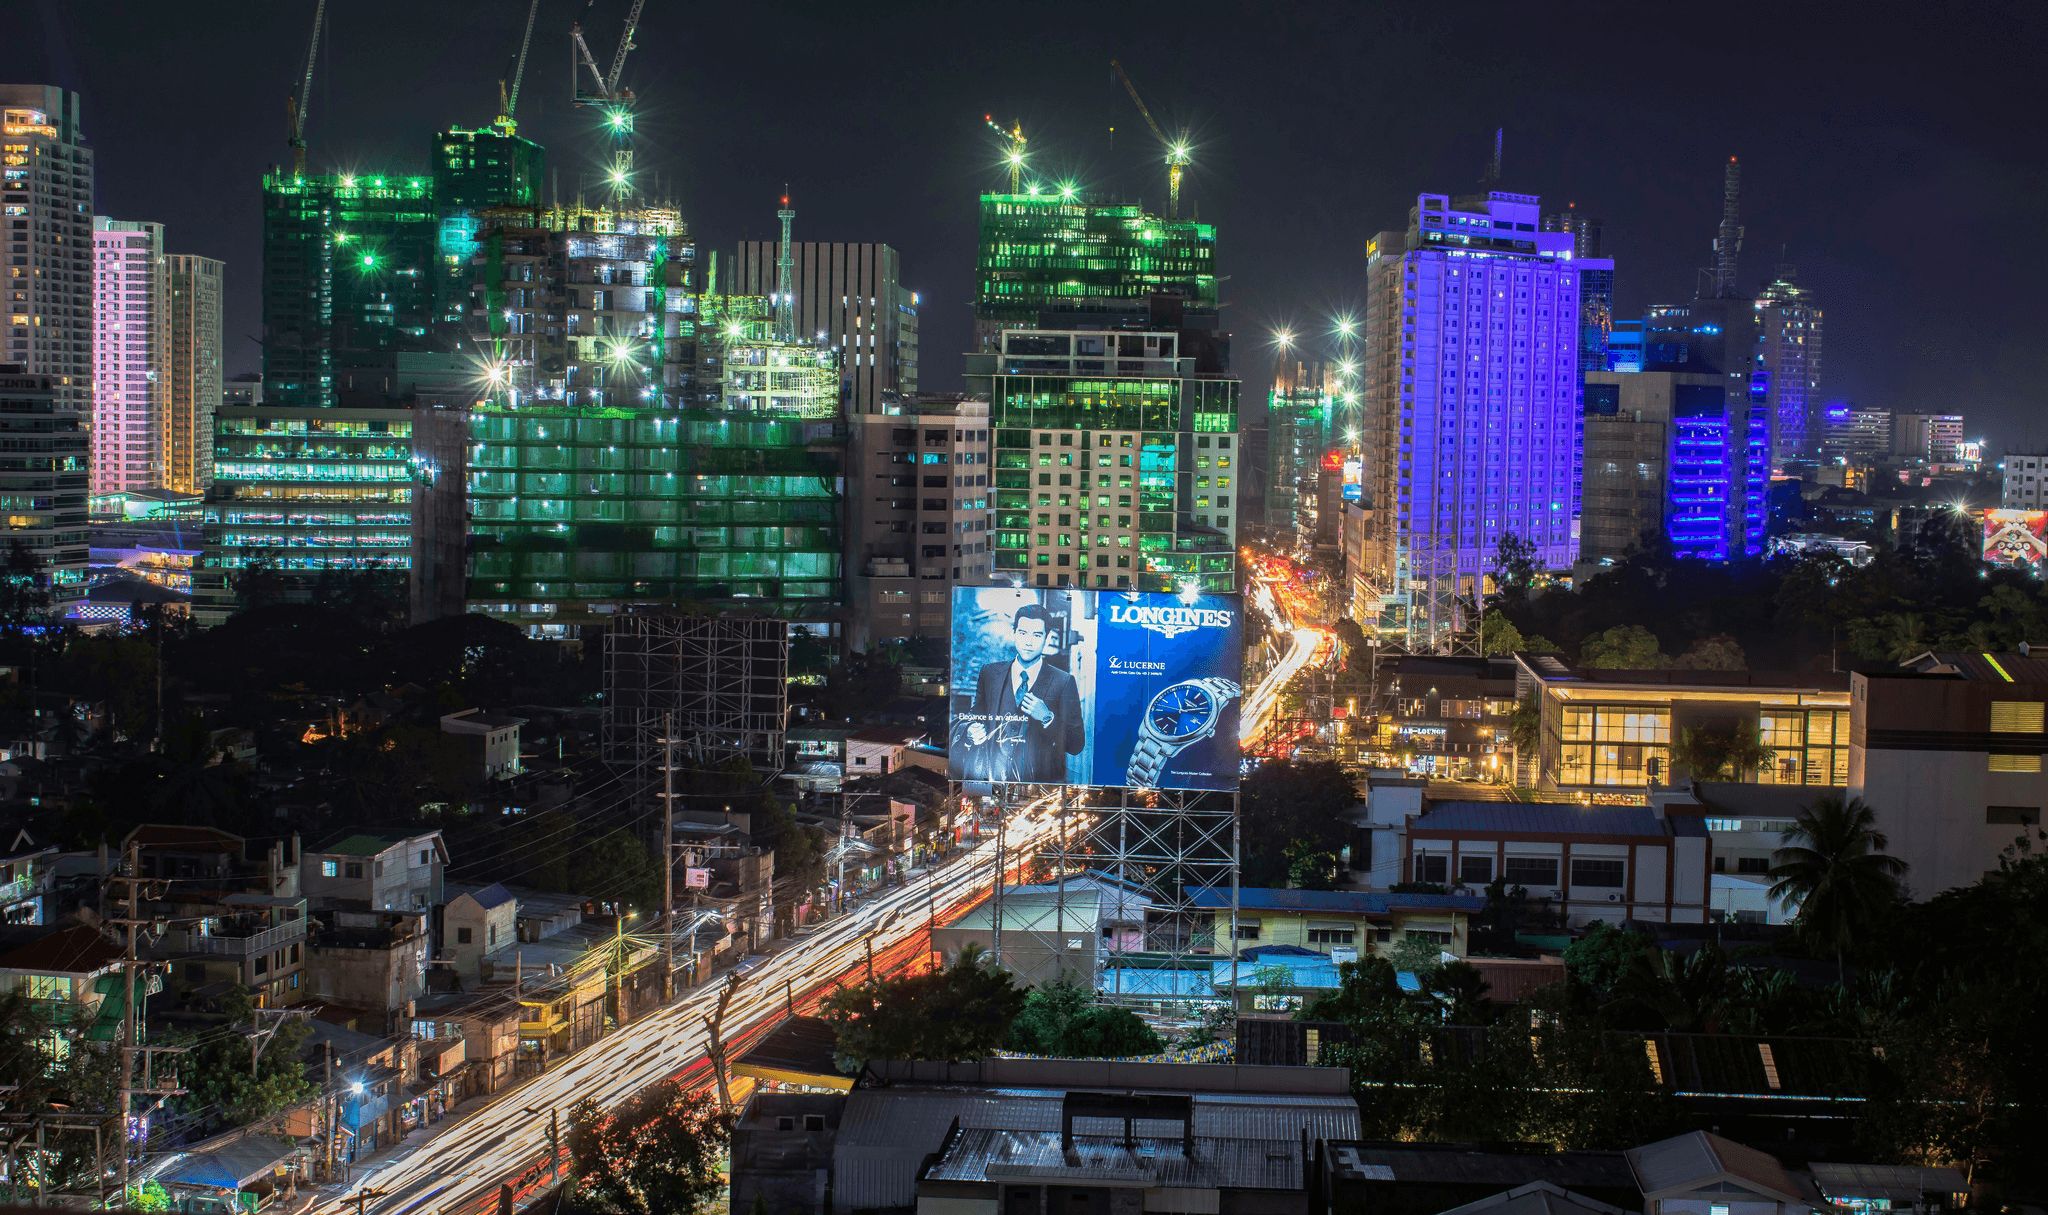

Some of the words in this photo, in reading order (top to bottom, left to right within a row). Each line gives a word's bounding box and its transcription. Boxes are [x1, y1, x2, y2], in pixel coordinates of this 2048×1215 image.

[1110, 605, 1231, 628] LONGINES
[1124, 661, 1166, 670] LUCERNE
[958, 712, 987, 722] Elegance
[988, 713, 994, 721] is
